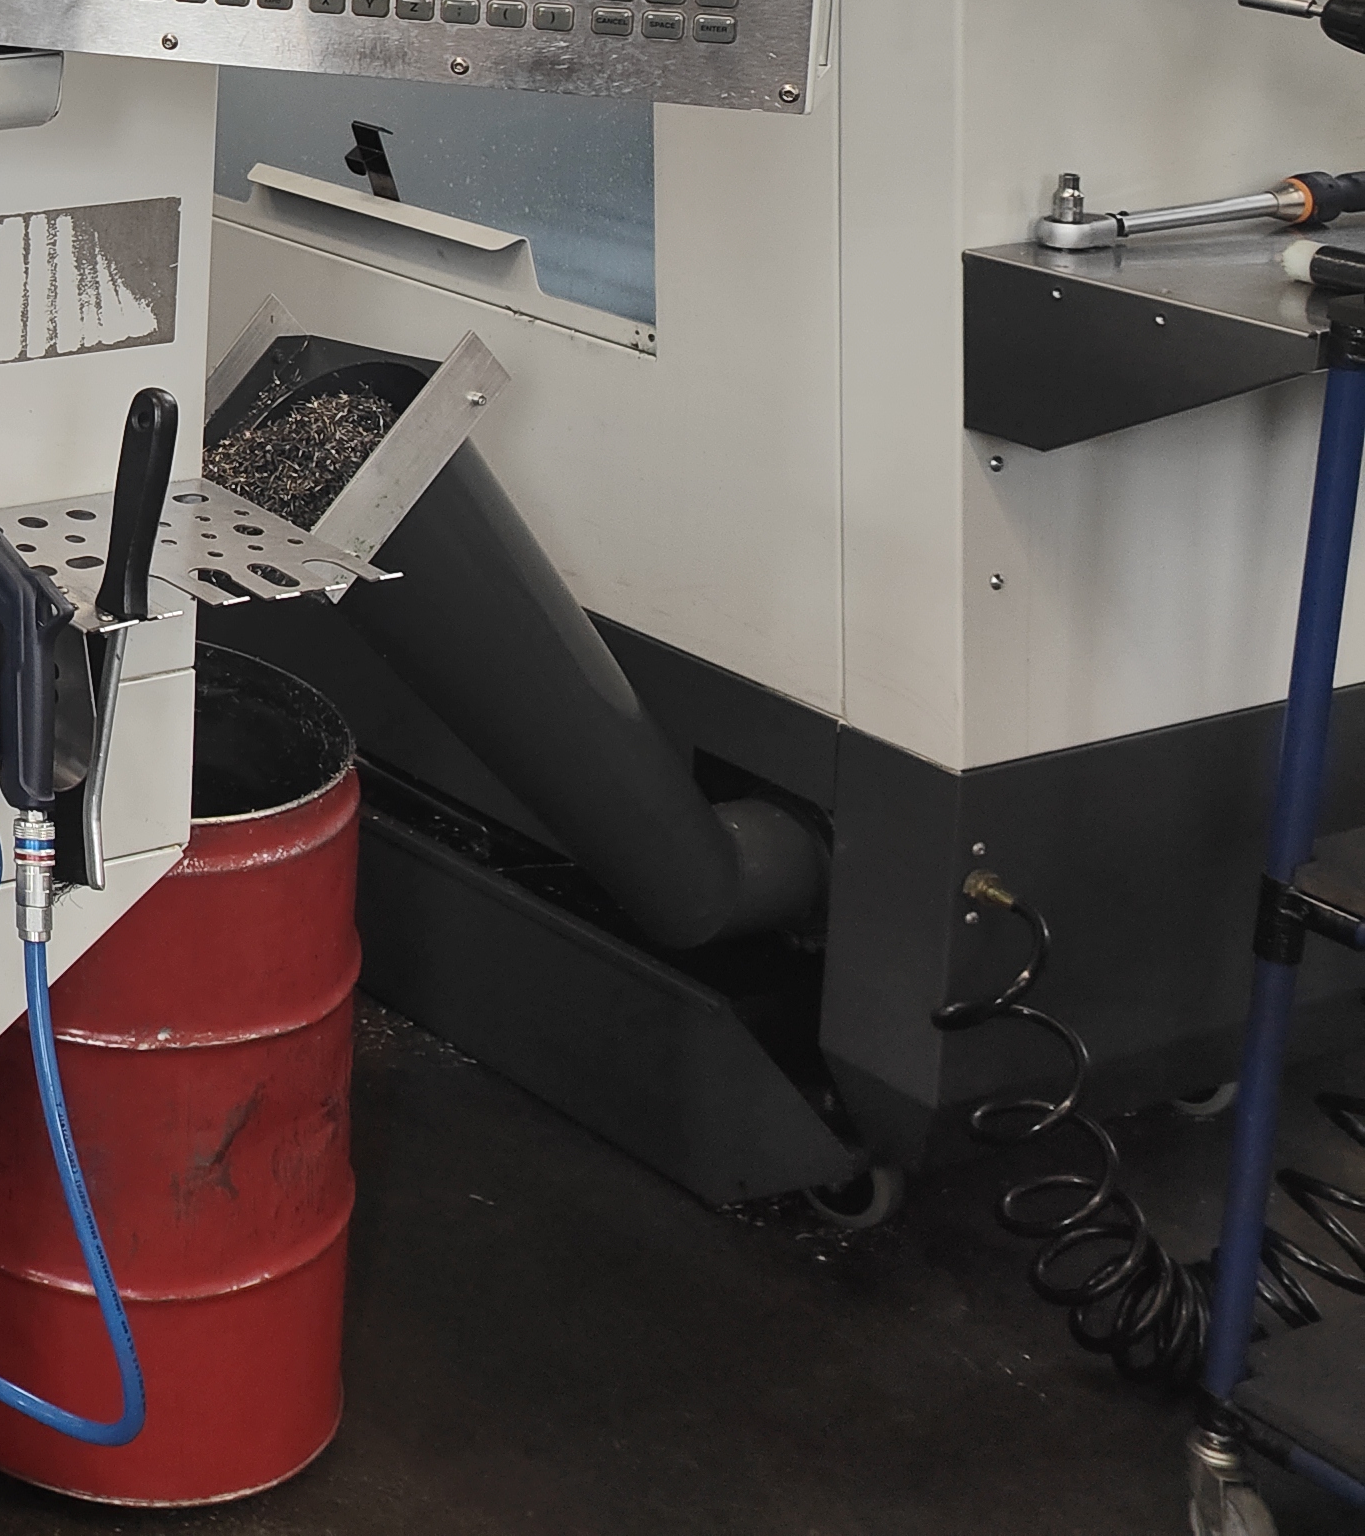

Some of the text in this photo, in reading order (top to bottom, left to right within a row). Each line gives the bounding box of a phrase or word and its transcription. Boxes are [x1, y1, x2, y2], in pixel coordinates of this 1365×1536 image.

[409, 2, 419, 13] Z
[595, 17, 628, 26] CANCEL
[649, 20, 675, 30] SPACE
[700, 24, 728, 33] ENTER
